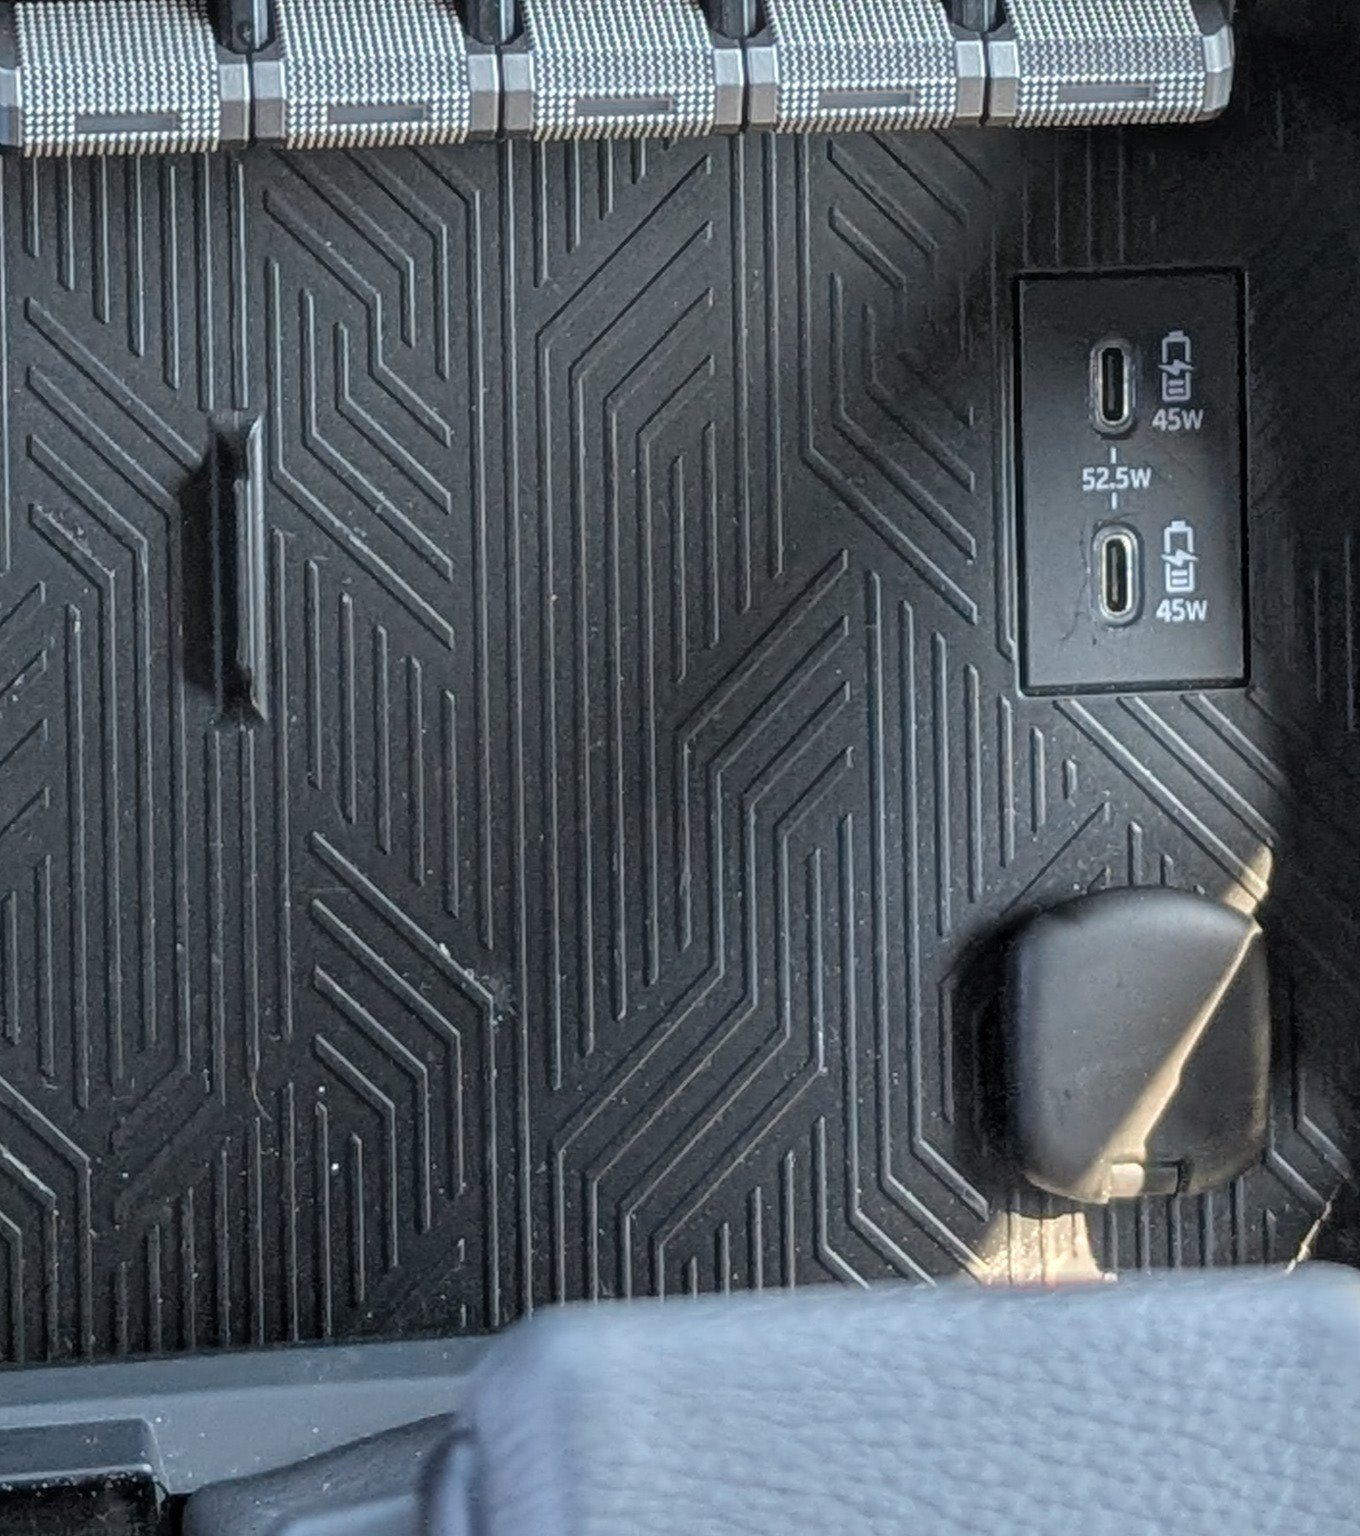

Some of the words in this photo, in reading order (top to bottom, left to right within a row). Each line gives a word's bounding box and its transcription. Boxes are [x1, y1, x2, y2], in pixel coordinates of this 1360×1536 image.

[1152, 408, 1204, 431] 45W
[1082, 467, 1152, 490] 52.5W
[1156, 599, 1207, 622] 45W
